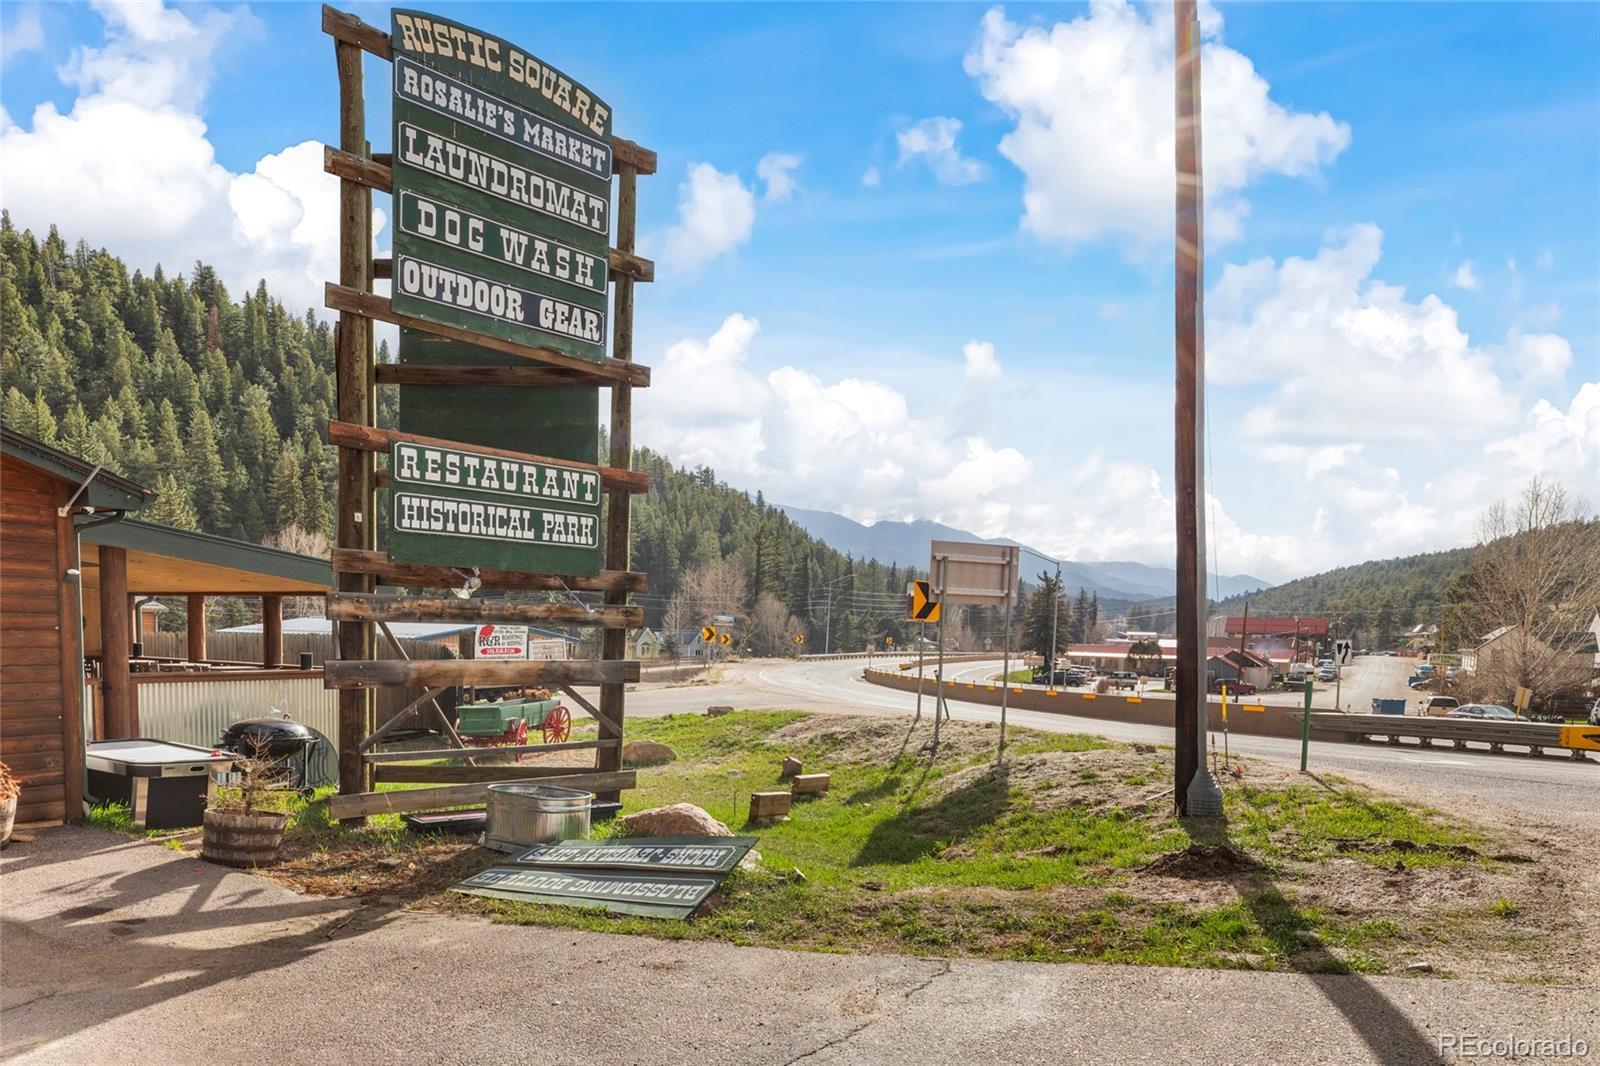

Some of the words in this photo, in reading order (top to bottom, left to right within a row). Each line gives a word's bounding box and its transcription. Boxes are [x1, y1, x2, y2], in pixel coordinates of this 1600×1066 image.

[395, 14, 501, 72] RUSTIC
[509, 49, 609, 137] SQUARE
[403, 66, 515, 136] ROSALIE'S
[523, 118, 606, 172] MARKET
[405, 127, 604, 229] LAUNDROMAT
[417, 200, 484, 252] DOG
[500, 228, 594, 287] WASH
[403, 260, 525, 322] OUTDOOR
[539, 298, 600, 342] GEAR
[400, 447, 596, 501] RESTAURANT
[401, 496, 535, 540] HISTORICAL
[542, 512, 594, 545] PARK
[472, 872, 573, 890] BOUTIQUE
[567, 880, 705, 900] BLOSSOMING
